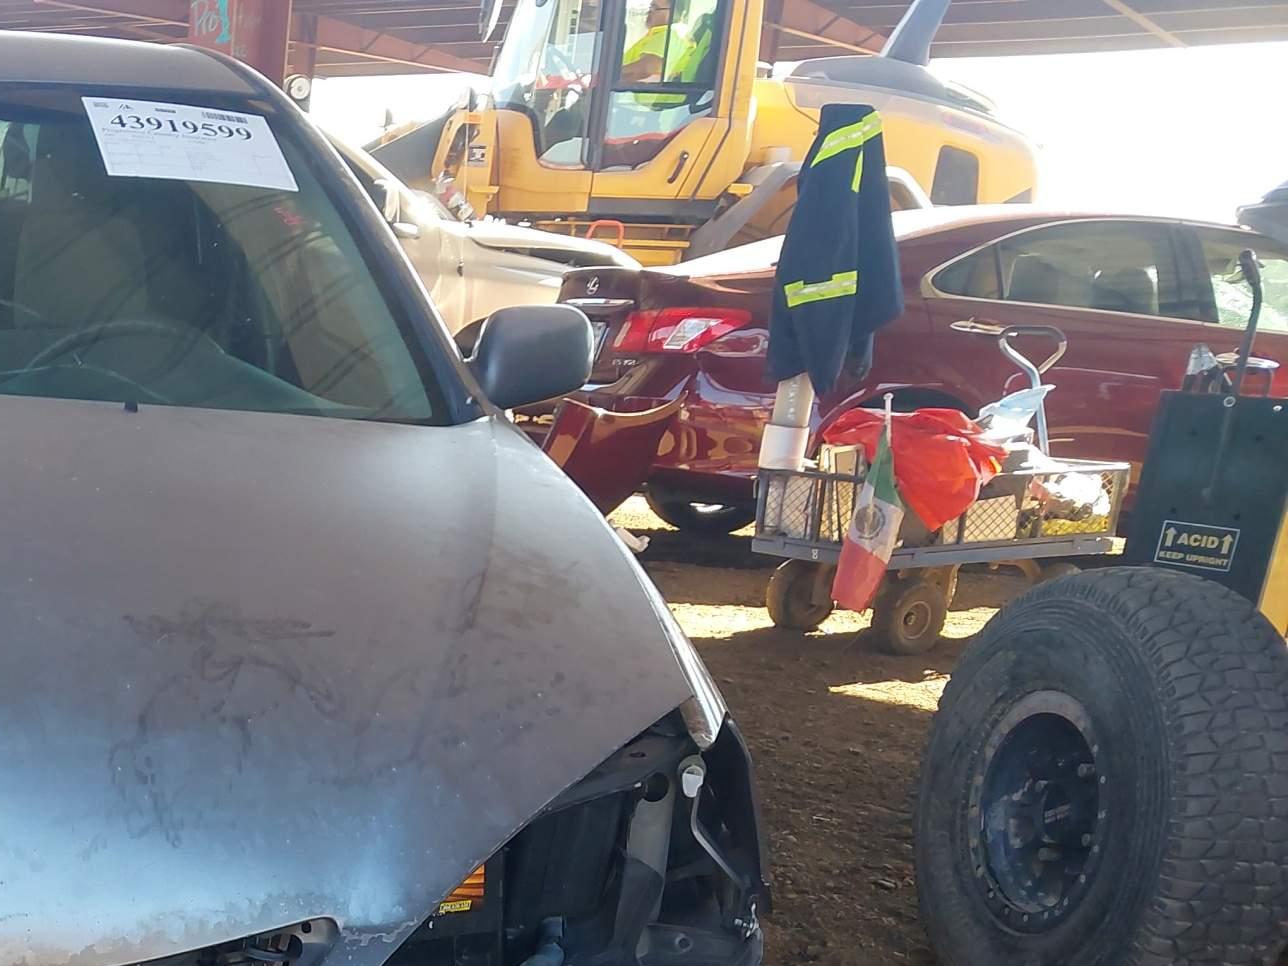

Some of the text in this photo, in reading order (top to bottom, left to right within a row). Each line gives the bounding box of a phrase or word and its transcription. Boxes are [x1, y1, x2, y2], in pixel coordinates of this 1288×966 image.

[110, 113, 253, 141] 43919599
[1176, 532, 1220, 549] ACID
[1158, 551, 1229, 567] KEEP UPRIGHT
